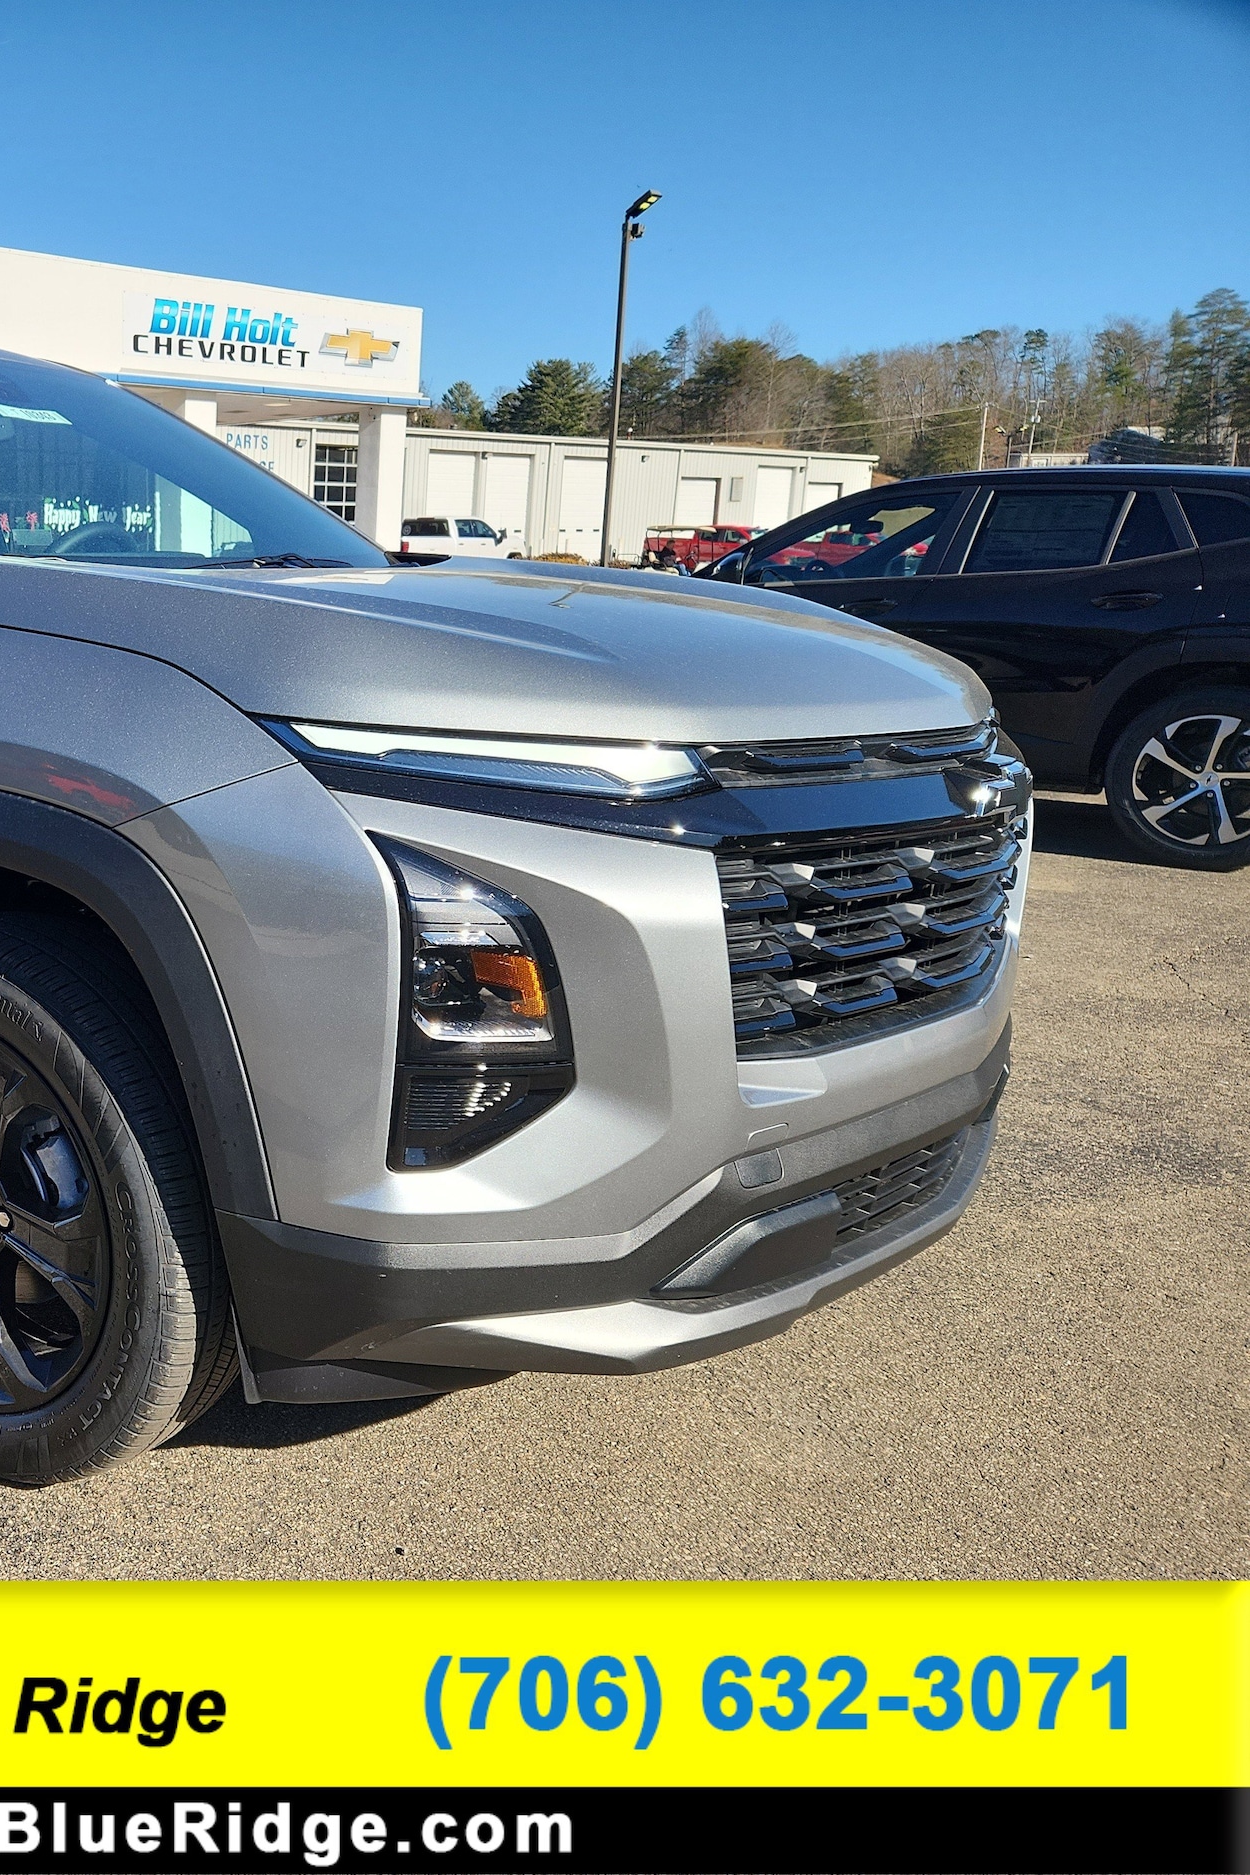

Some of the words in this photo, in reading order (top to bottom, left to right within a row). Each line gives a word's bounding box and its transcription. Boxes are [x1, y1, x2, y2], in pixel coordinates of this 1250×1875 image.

[149, 298, 215, 339] Bill
[221, 306, 299, 348] Holt
[132, 333, 310, 368] CHEVROLET
[226, 432, 269, 451] PARTS
[44, 503, 81, 533] Happy
[88, 505, 118, 524] New
[122, 506, 152, 533] Year
[78, 1181, 141, 1432] CROSSCONTACT
